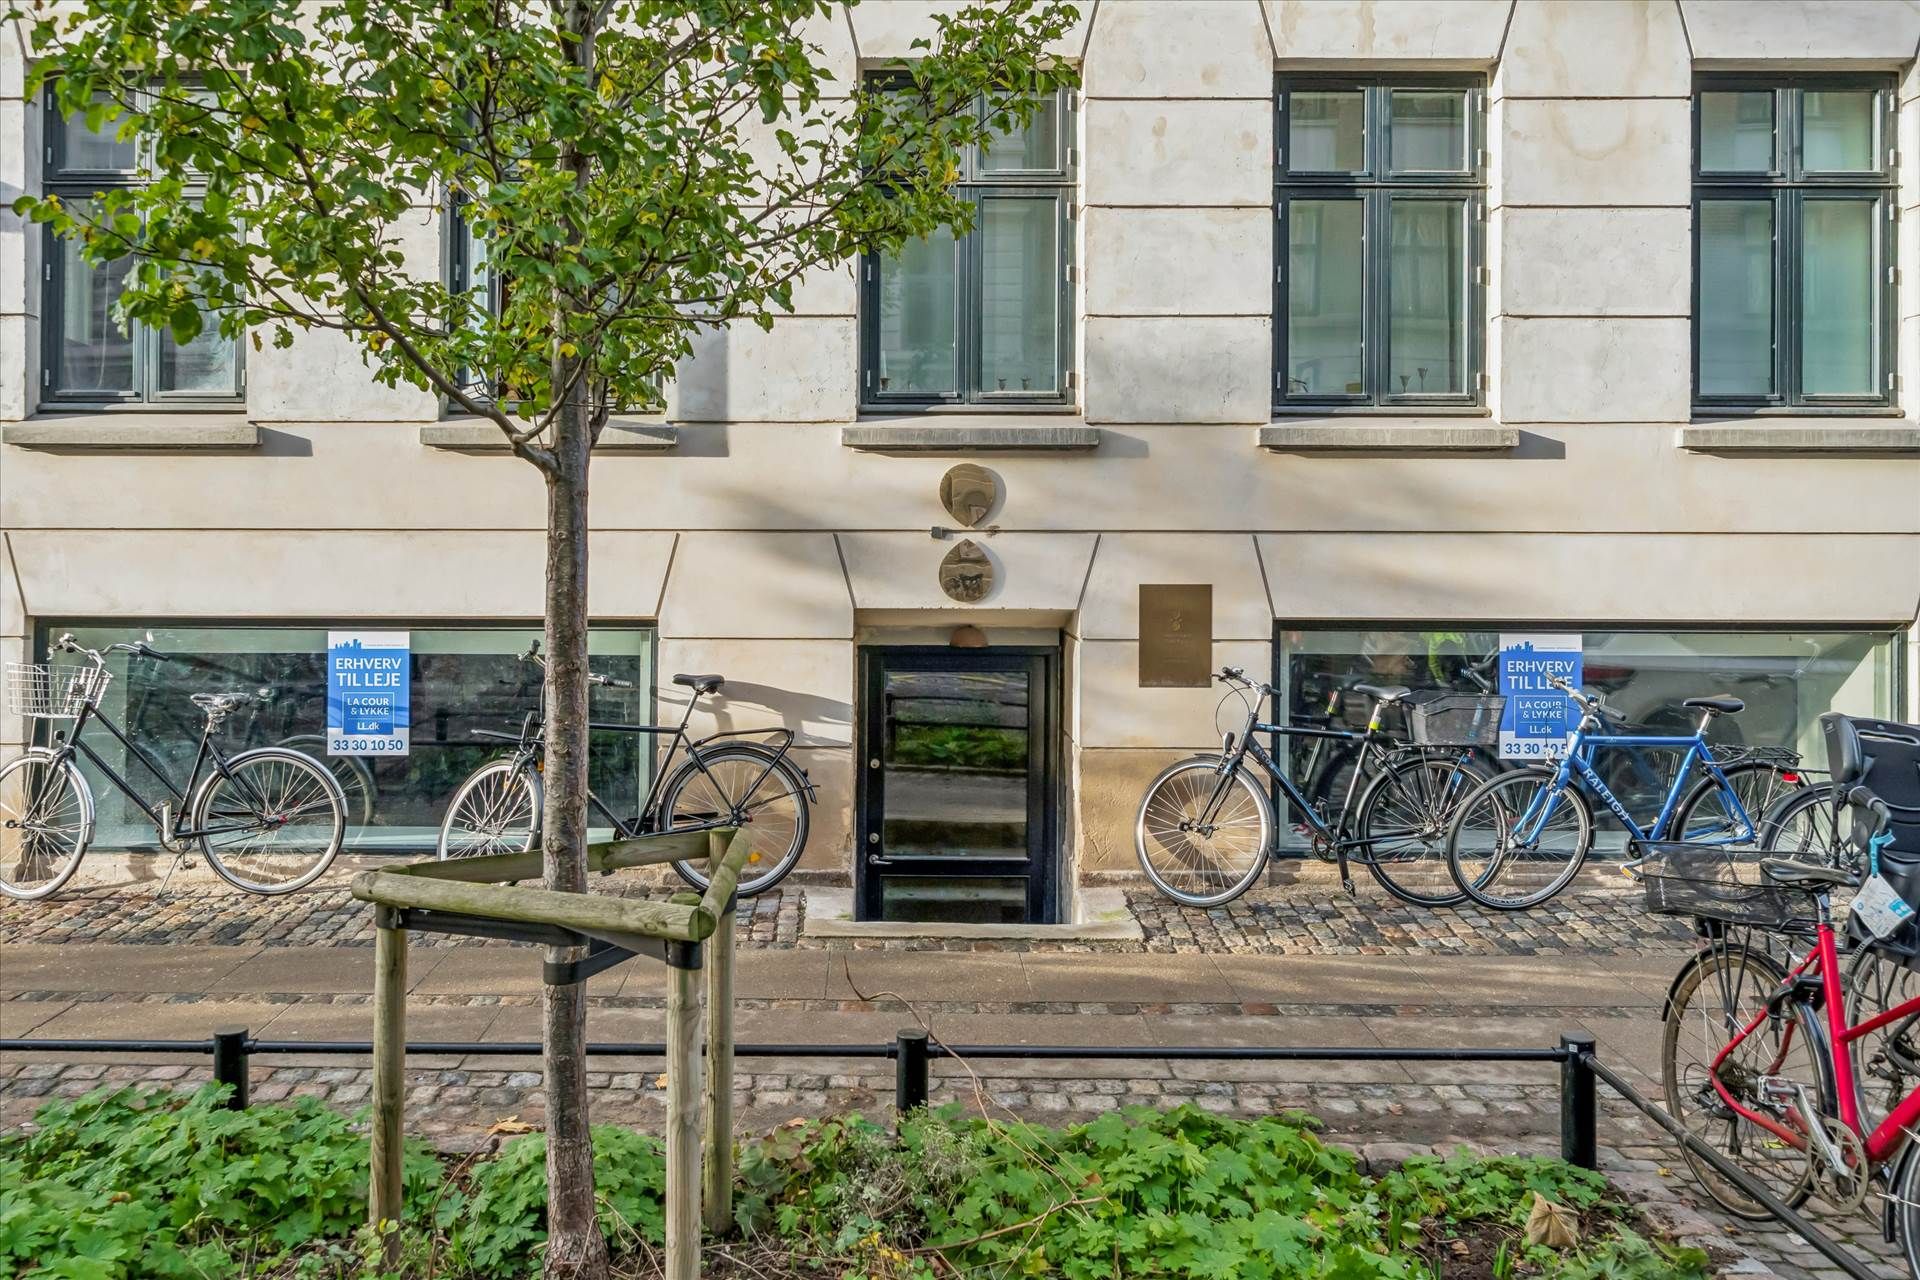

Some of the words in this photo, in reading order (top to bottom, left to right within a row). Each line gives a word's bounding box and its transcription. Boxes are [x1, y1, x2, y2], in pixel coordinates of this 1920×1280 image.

[336, 658, 402, 669] ERHVERV
[1507, 661, 1574, 672] ERHVERV
[336, 673, 361, 687] TIL
[364, 673, 401, 687] LEJE
[1508, 676, 1533, 690] TIL
[1537, 676, 1574, 690] LEE
[347, 697, 359, 706] LA
[361, 697, 389, 706] COUR
[1519, 701, 1531, 710] LA
[1533, 701, 1562, 710] COUR
[351, 707, 357, 716] &
[359, 707, 389, 716] LYKKE
[1522, 710, 1529, 719] &
[1532, 710, 1562, 719] LYKKE
[333, 739, 349, 751] 33
[351, 739, 367, 751] 30
[371, 739, 385, 751] 10
[388, 739, 403, 751] 50
[1505, 743, 1520, 755] 33
[1524, 743, 1539, 755] 30
[1583, 767, 1630, 821] RALEIGH
